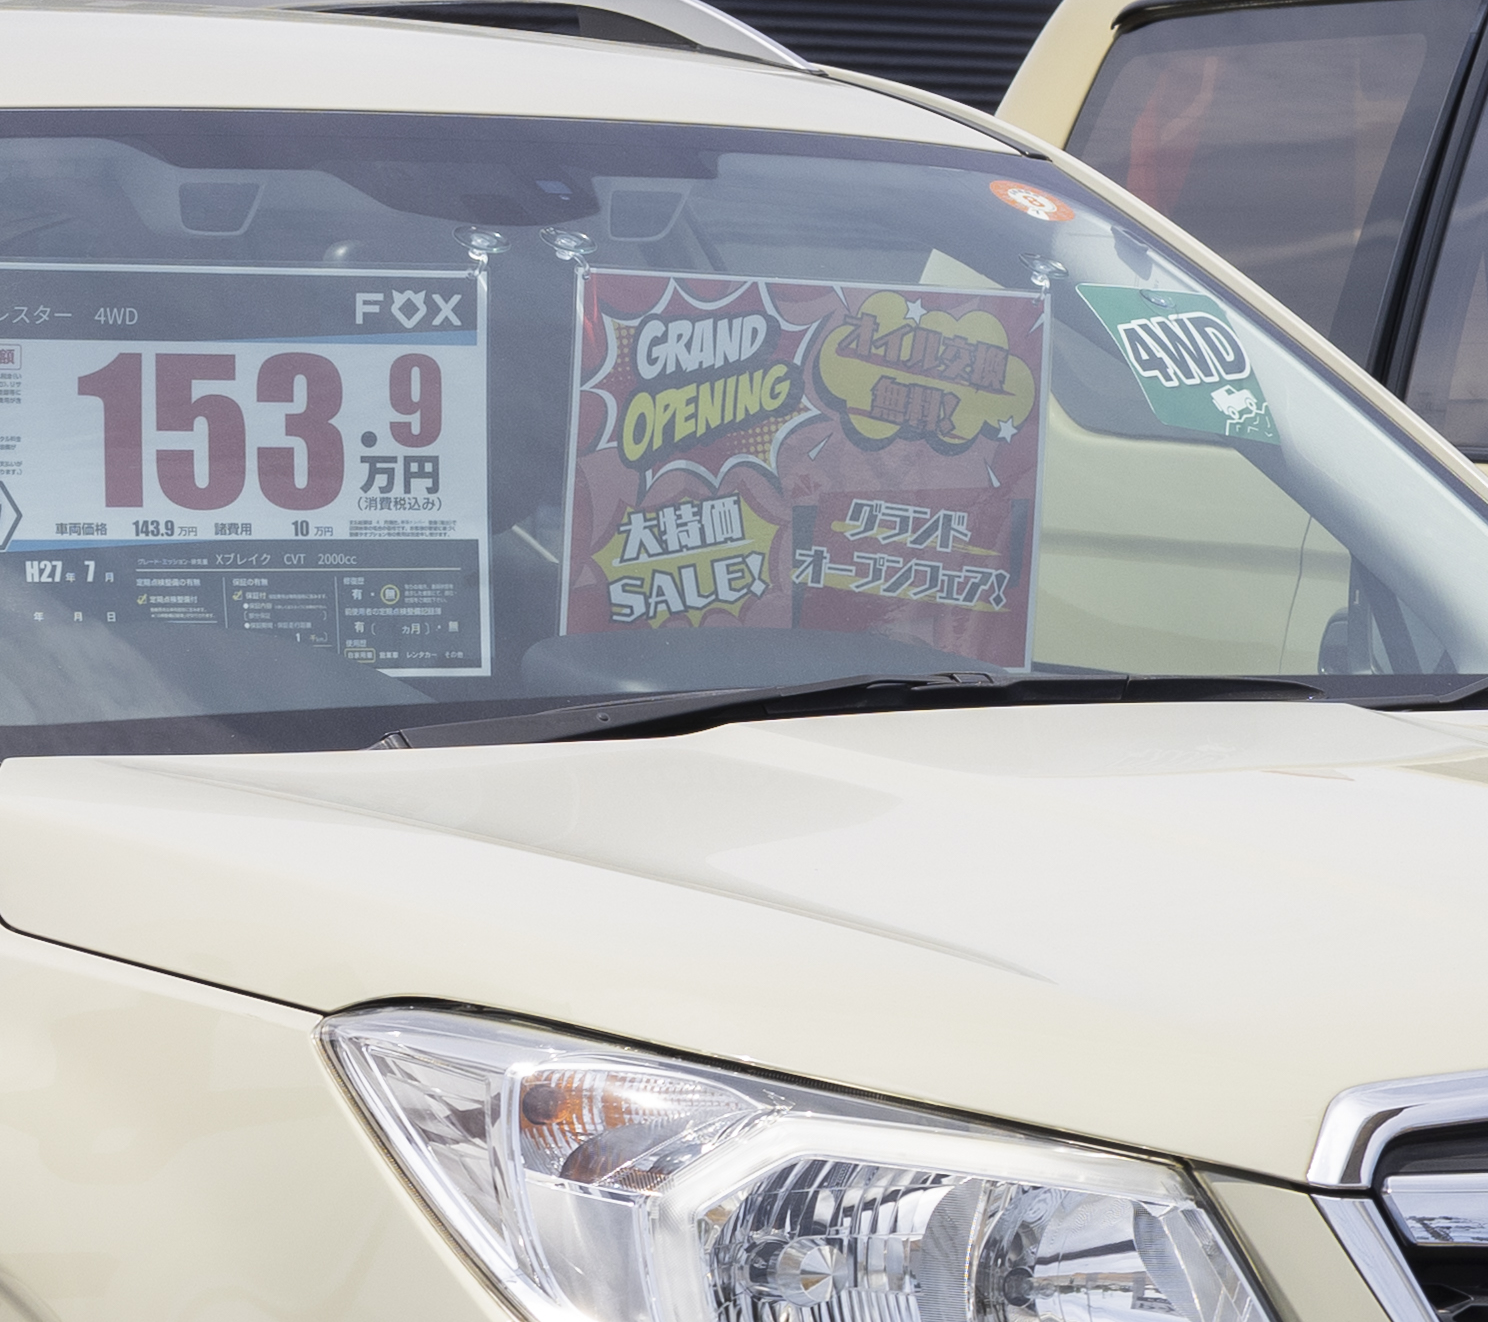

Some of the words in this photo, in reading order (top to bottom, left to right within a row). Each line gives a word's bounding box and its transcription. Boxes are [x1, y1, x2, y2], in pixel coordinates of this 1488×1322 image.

[94, 307, 138, 325] 4WD
[355, 289, 462, 329] FOX
[636, 313, 768, 380] GRAND
[1116, 311, 1251, 388] 4WD
[78, 351, 443, 511] 153.9
[622, 363, 791, 463] OPENING
[360, 455, 440, 495] 万円
[55, 522, 107, 536] 車両価格
[132, 520, 175, 537] 143.9
[177, 526, 198, 537] 万円
[214, 523, 252, 536] 諸費用
[292, 520, 309, 537] 10
[314, 526, 333, 537] 万円
[618, 494, 745, 565] 大特価
[844, 498, 972, 553] グランド
[25, 560, 63, 583] H27
[65, 572, 76, 583] 年
[84, 560, 95, 583] 7
[105, 572, 114, 583] 月
[215, 553, 271, 566] Xブレイク
[284, 553, 306, 565] CVT
[318, 553, 357, 565] 2000cc
[608, 552, 769, 623] SALE!
[791, 547, 1010, 610] オープンフェア!
